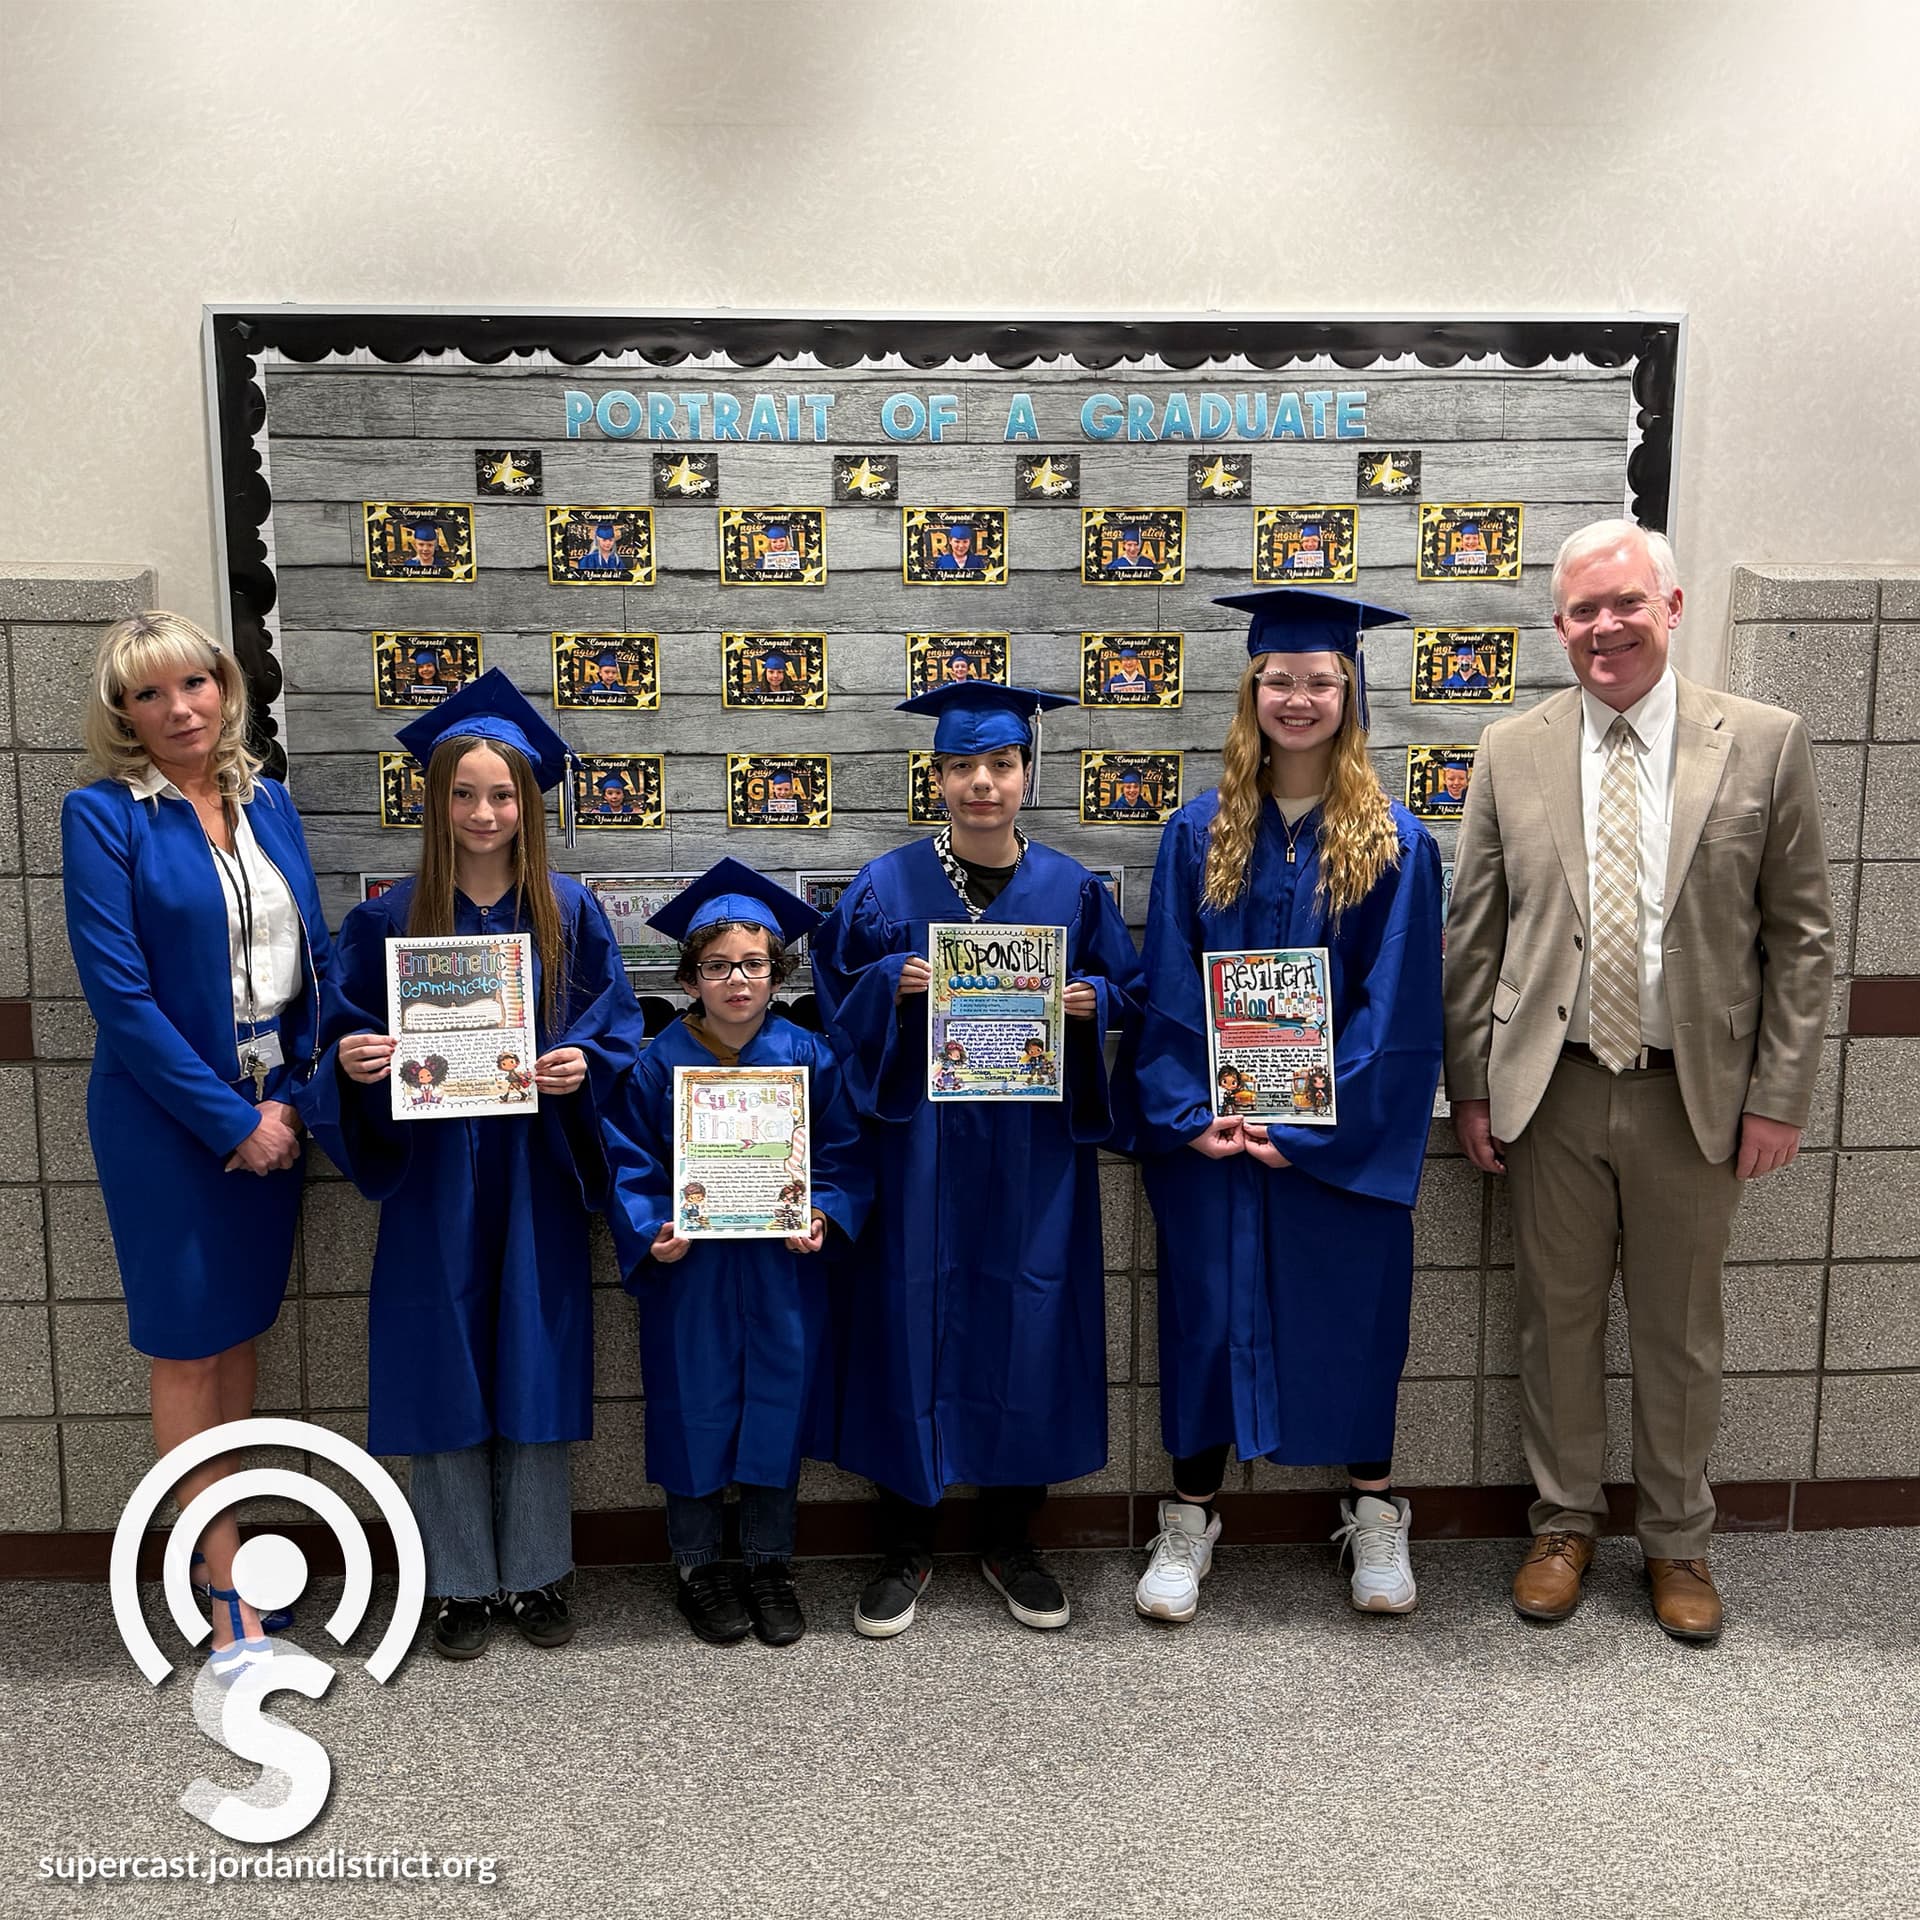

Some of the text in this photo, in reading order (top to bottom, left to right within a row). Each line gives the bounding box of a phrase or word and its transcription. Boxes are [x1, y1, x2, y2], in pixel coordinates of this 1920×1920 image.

[564, 390, 1368, 442] PORTRAIT OF A GRADUATE
[400, 508, 438, 519] Congrats!
[582, 511, 620, 522] Congrats!
[754, 512, 791, 523] Congrats!
[937, 512, 975, 522] Congrats!
[1116, 512, 1152, 523] Congrats!
[1288, 511, 1324, 522] Congrats!
[1453, 508, 1490, 519] Congrats!
[403, 567, 420, 577] You
[584, 571, 601, 580] You
[755, 571, 772, 580] You
[938, 571, 954, 580] You
[1115, 571, 1132, 580] You
[1287, 569, 1303, 579] You
[1451, 566, 1467, 576] You
[409, 637, 447, 648] Congrats!
[587, 639, 624, 648] Congrats!
[757, 639, 793, 648] Congrats!
[941, 639, 976, 648] Congrats!
[1114, 638, 1151, 648] Congrats!
[1448, 633, 1485, 644] Congrats!
[1114, 695, 1131, 704] You
[1446, 690, 1463, 699] You
[411, 696, 428, 704] You
[589, 696, 606, 704] You
[757, 696, 774, 704] You
[1441, 750, 1474, 760] Congrats
[593, 759, 630, 769] Congrats!
[761, 759, 797, 769] Congrats!
[1114, 756, 1150, 766] Congrats!
[1113, 811, 1129, 820] You
[1439, 806, 1454, 815] You
[595, 816, 612, 825] You
[762, 815, 779, 824] You
[400, 949, 506, 978] Empathetic
[1221, 956, 1317, 992] Resilient
[401, 976, 507, 999] Communicator
[694, 1087, 791, 1113] Curious
